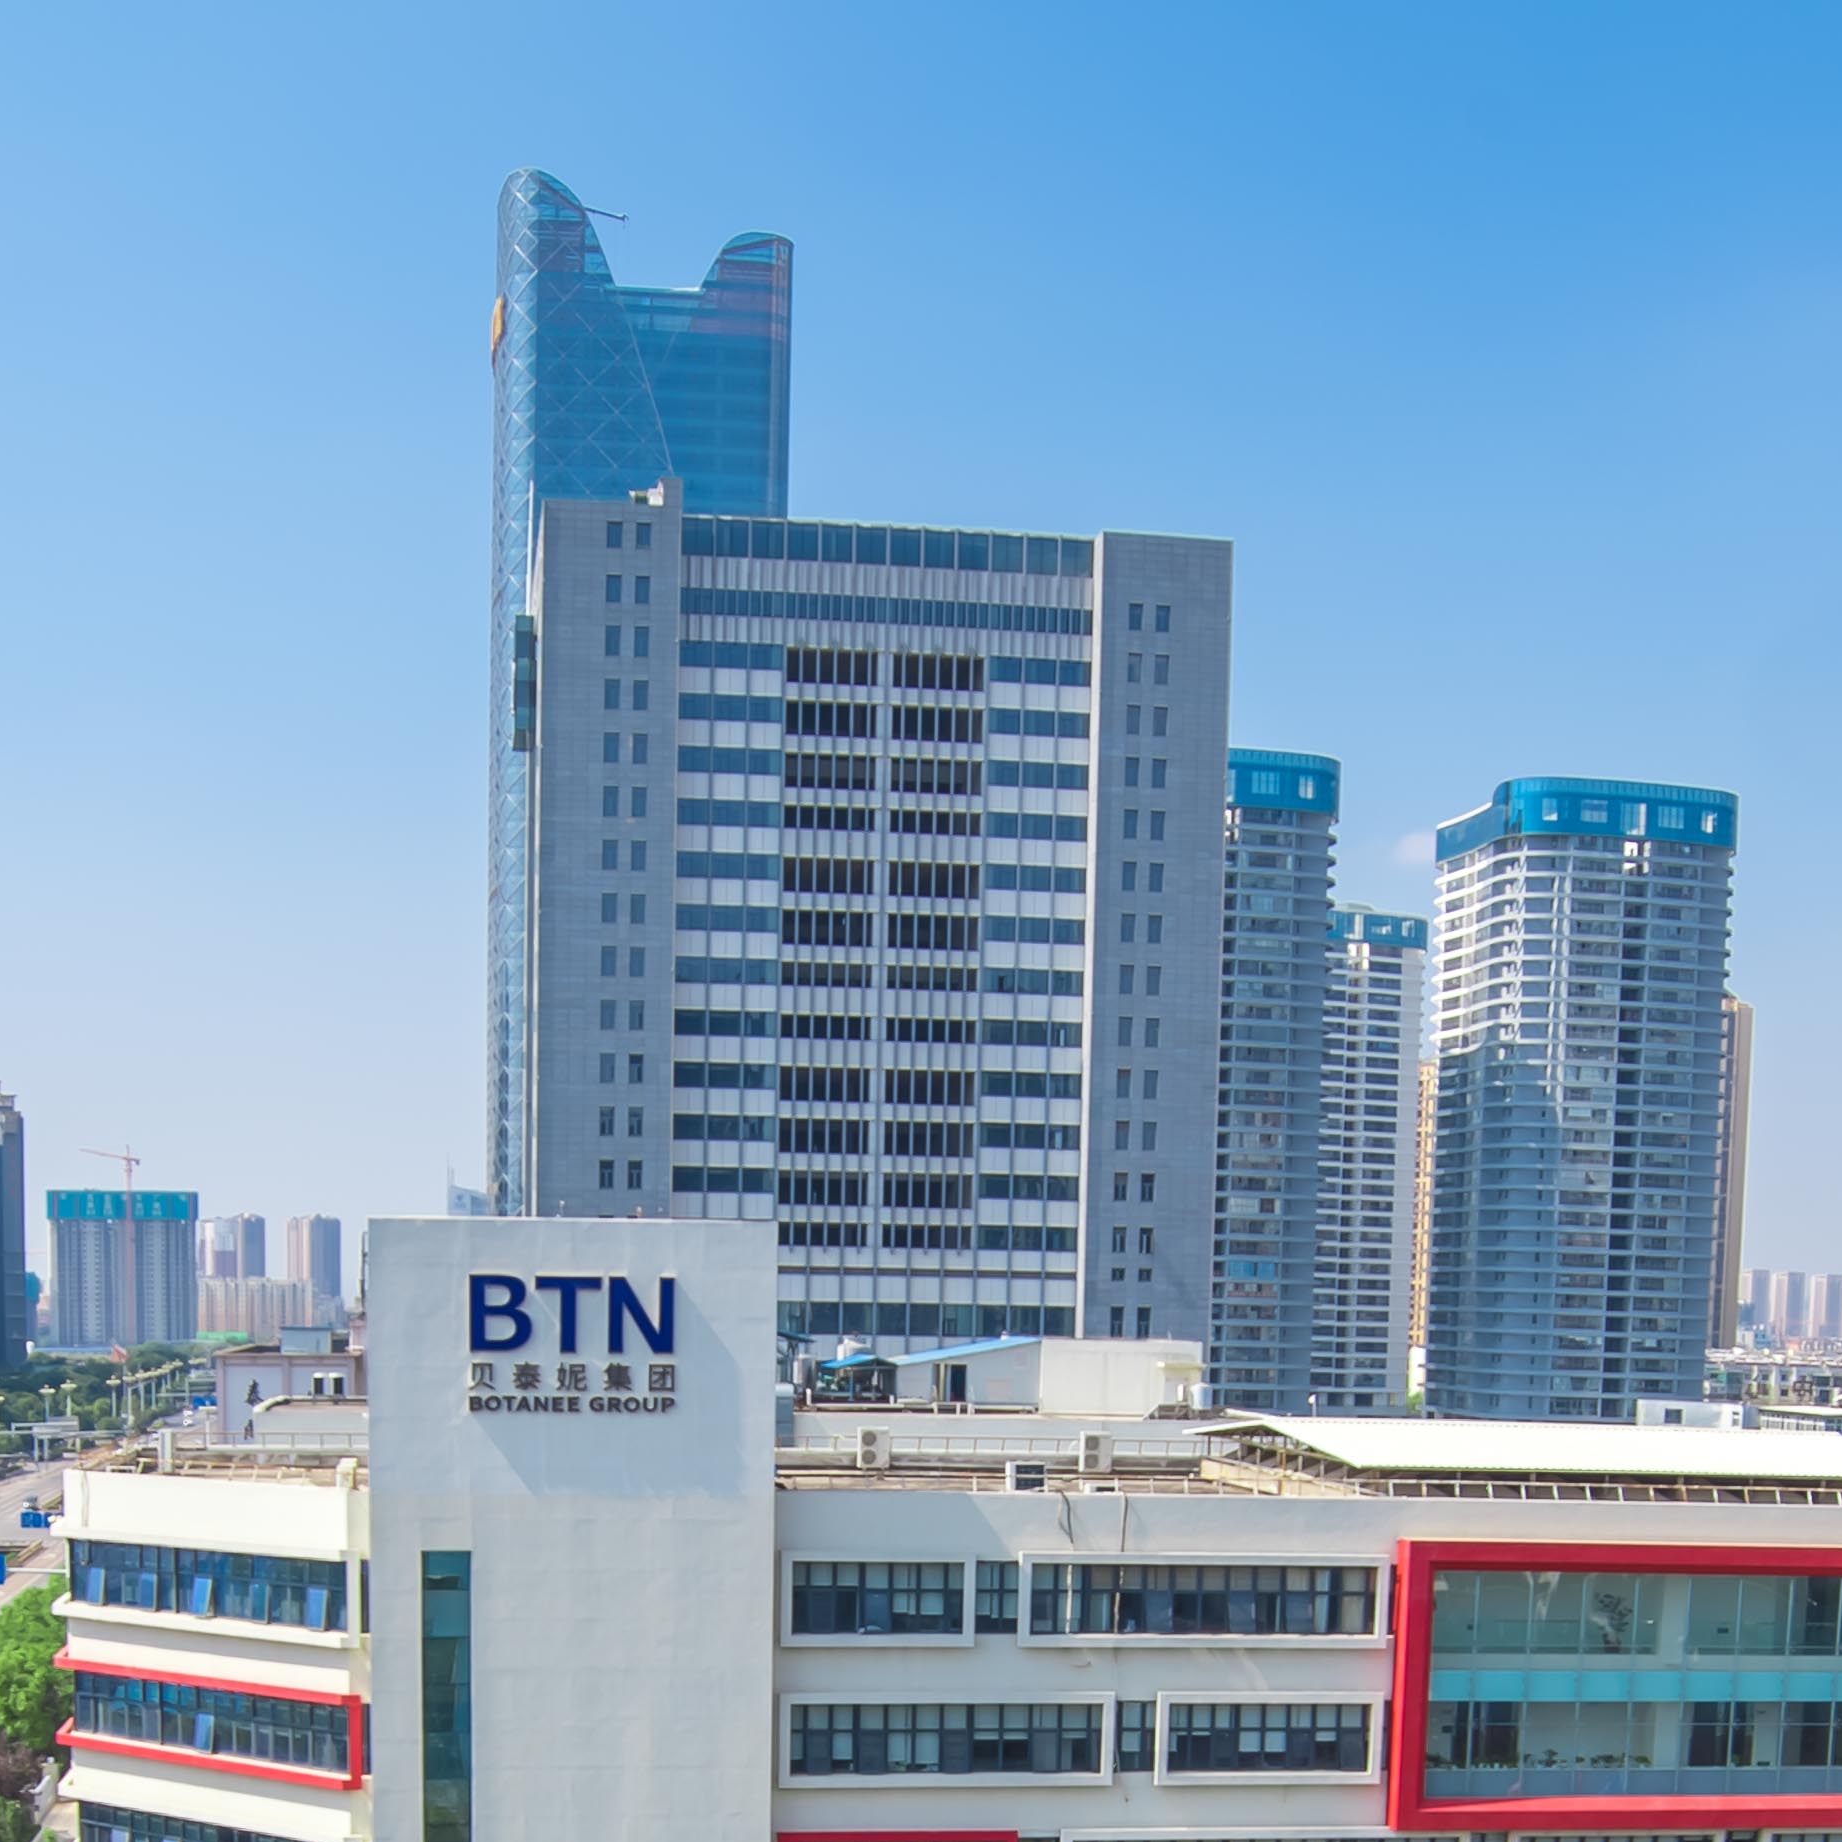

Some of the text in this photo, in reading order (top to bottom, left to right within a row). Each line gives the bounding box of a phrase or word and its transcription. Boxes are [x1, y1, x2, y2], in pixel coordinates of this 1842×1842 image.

[469, 1274, 675, 1353] BTN
[469, 1362, 675, 1392] 贝泰妮集团
[469, 1395, 675, 1413] BOTANEE GROUP
